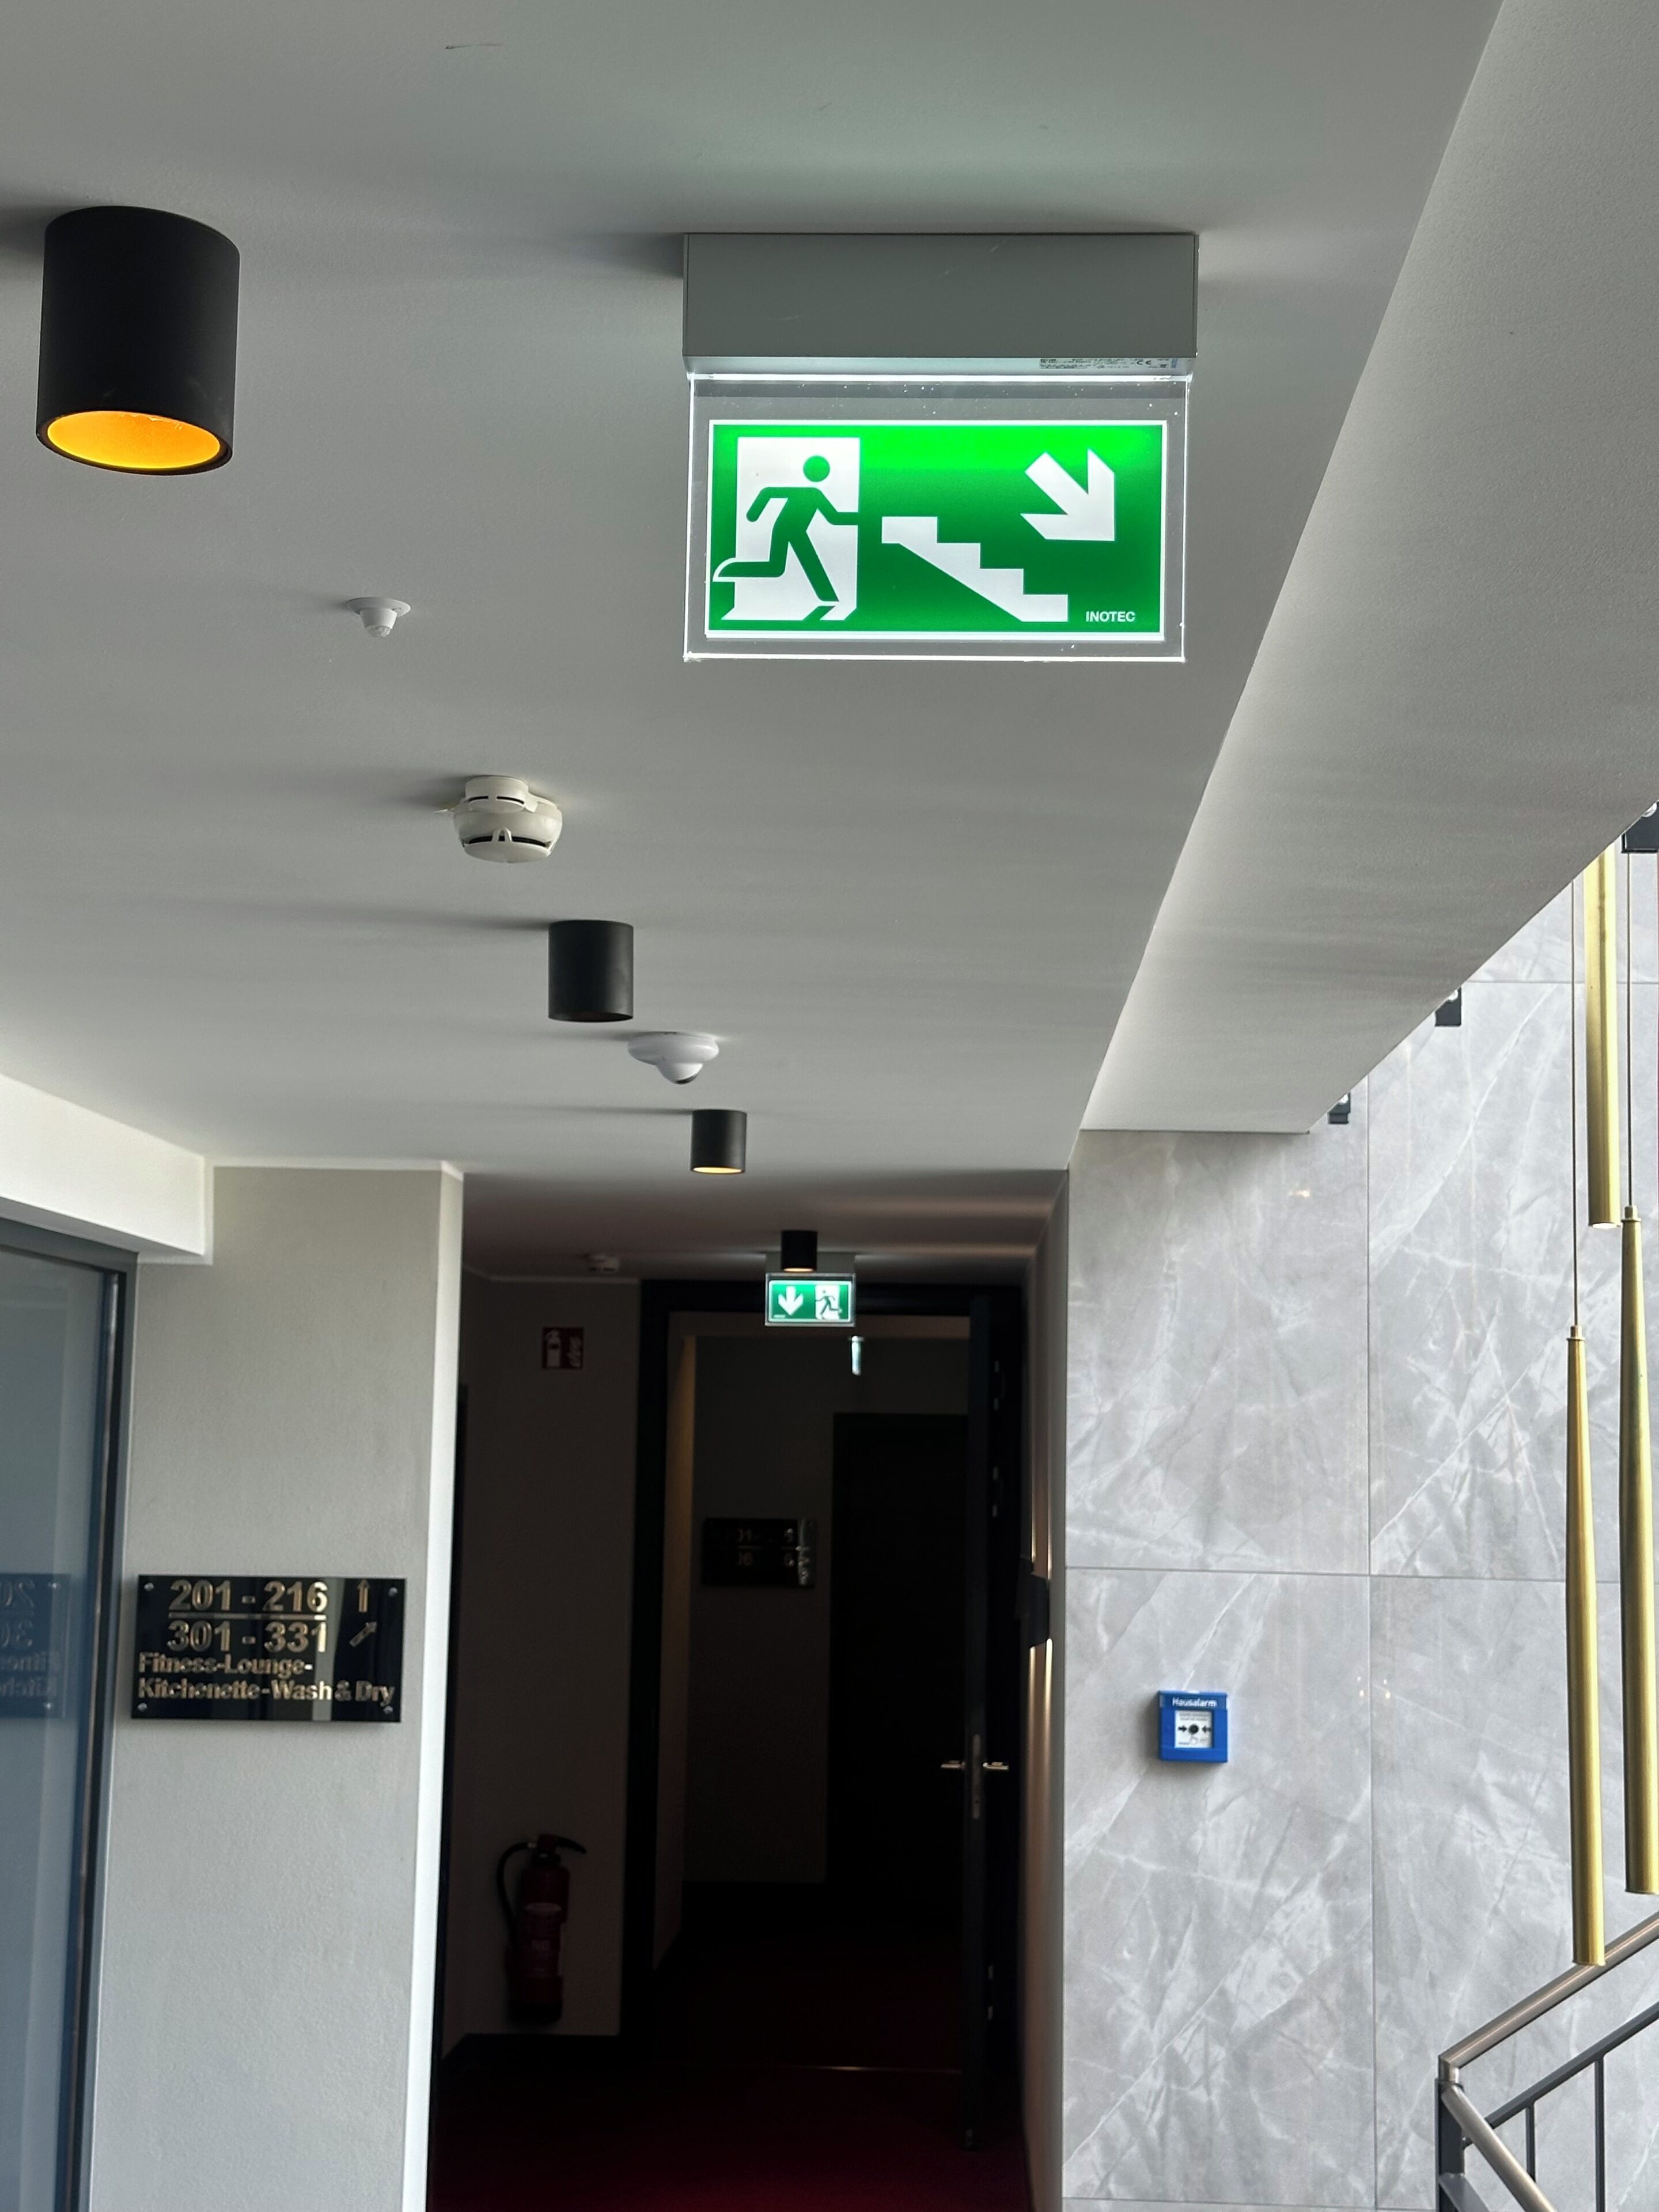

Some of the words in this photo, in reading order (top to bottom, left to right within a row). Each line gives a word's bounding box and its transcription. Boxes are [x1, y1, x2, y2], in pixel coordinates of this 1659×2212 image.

[1086, 611, 1135, 622] INOTEC
[169, 1579, 230, 1611] 201
[263, 1581, 327, 1613] 216
[166, 1620, 230, 1652] 301
[264, 1621, 326, 1653] 331
[335, 1680, 351, 1701] &
[355, 1680, 395, 1707] Dry
[1172, 1697, 1217, 1707] Hausalarm
